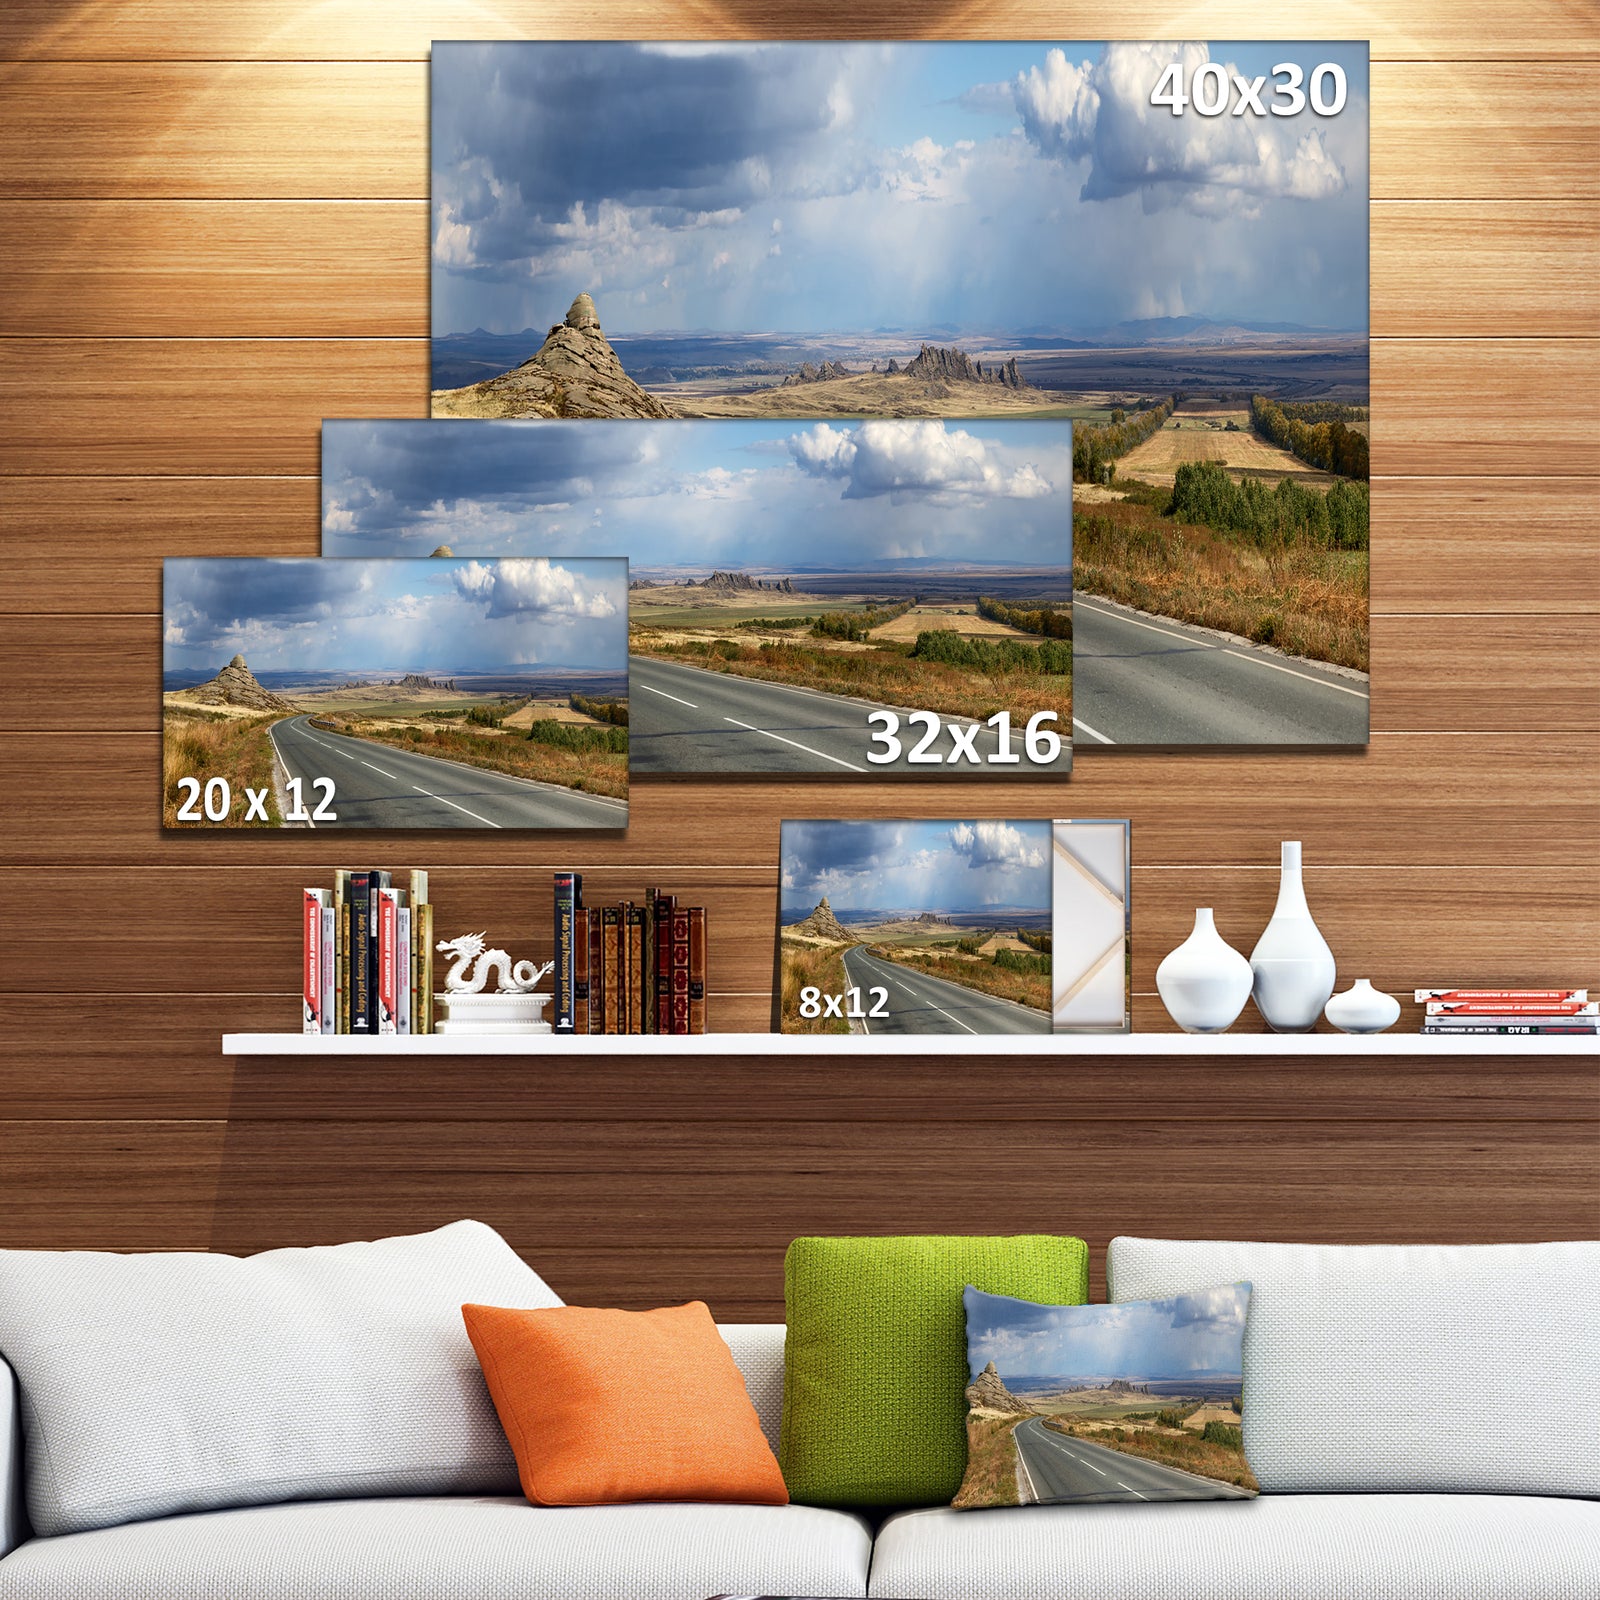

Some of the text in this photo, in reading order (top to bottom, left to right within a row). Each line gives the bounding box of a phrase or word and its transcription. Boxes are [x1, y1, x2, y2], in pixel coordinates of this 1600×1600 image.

[358, 914, 367, 930] Audio
[562, 914, 570, 930] Audio
[356, 931, 367, 949] Signal
[560, 931, 570, 949] Signal
[356, 950, 367, 980] Processing
[560, 950, 570, 980] Processing
[358, 981, 367, 992] and
[562, 981, 570, 992] and
[356, 993, 367, 1012] Coding
[560, 993, 570, 1012] Coding
